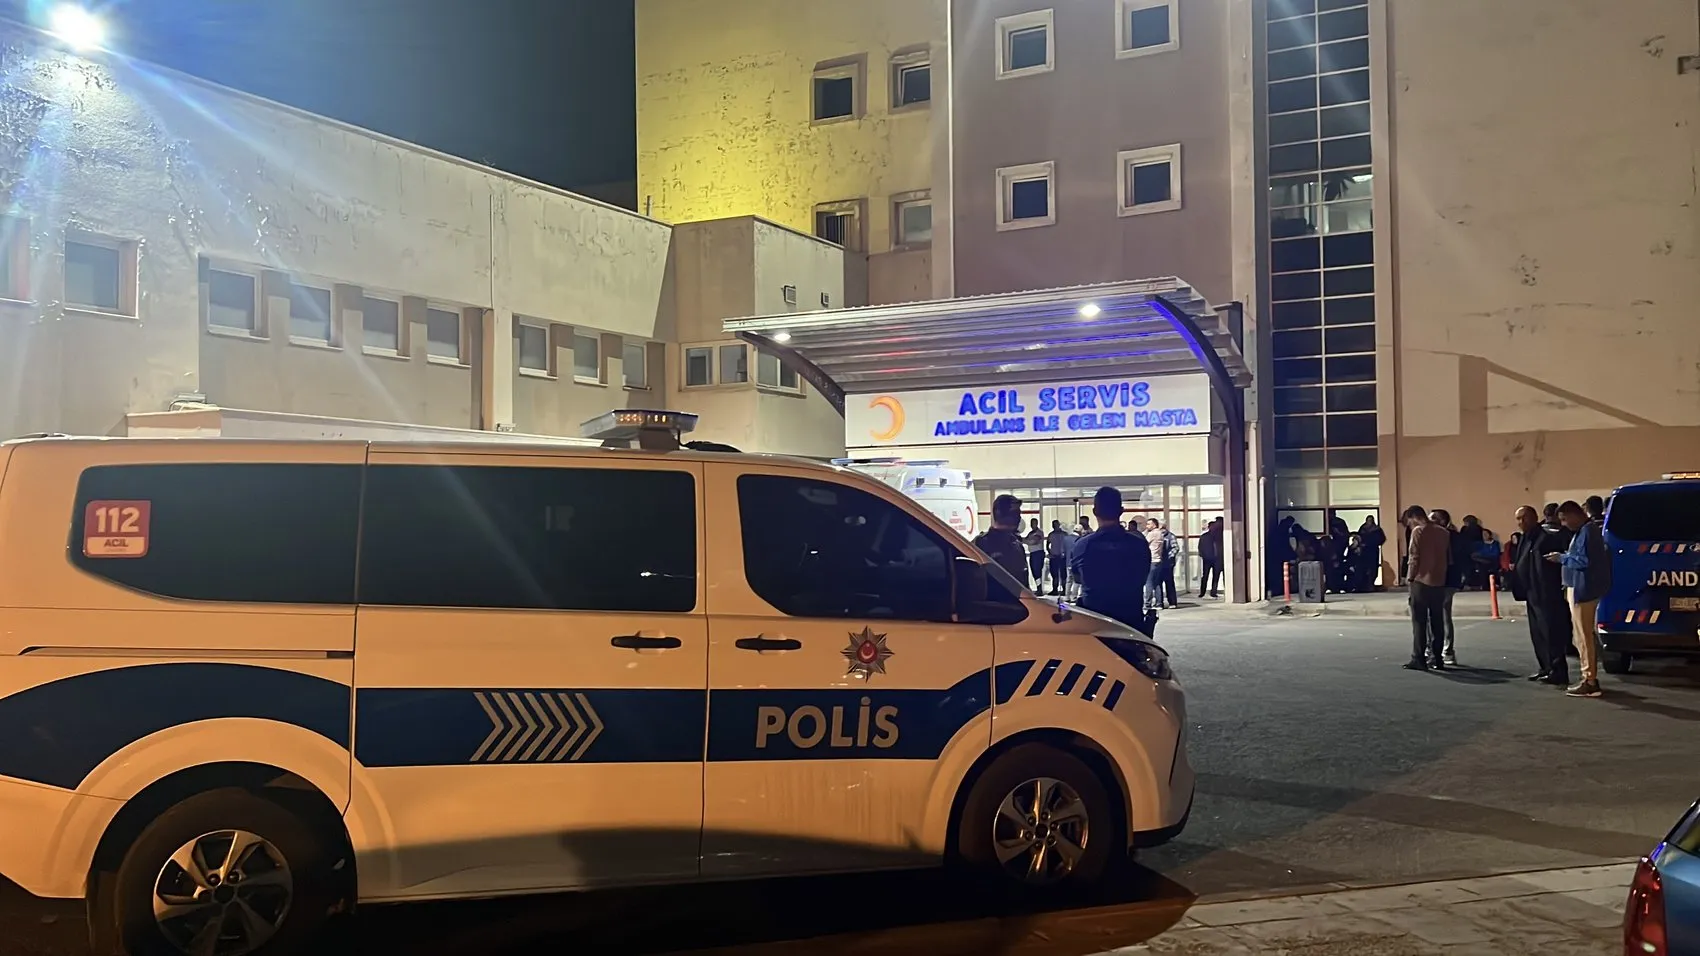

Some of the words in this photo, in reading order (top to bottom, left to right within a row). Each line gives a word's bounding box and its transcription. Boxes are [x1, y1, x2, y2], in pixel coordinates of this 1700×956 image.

[1038, 382, 1151, 412] SERVİS
[934, 417, 1025, 436] AMBULANS
[1067, 412, 1126, 431] GELEN
[1134, 408, 1198, 428] HASTA
[95, 506, 140, 533] 112
[755, 696, 899, 748] POLİS
